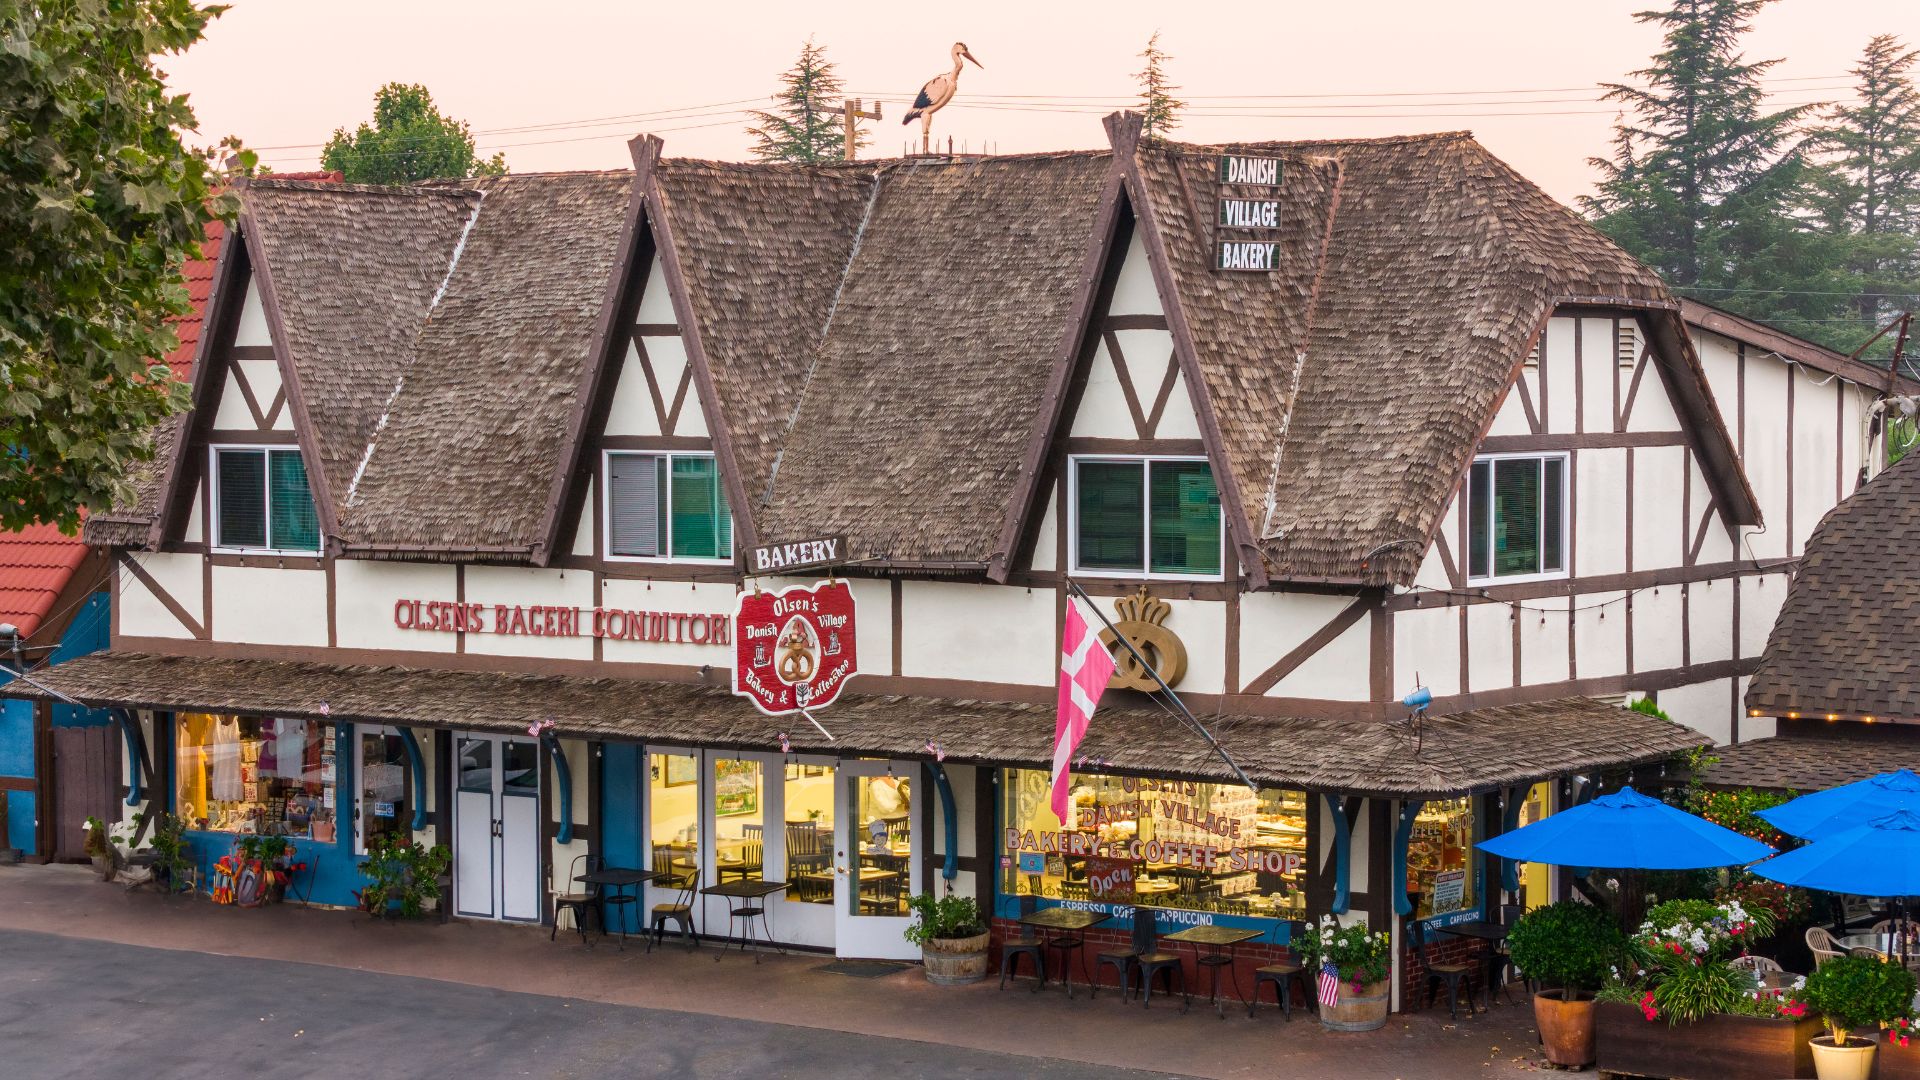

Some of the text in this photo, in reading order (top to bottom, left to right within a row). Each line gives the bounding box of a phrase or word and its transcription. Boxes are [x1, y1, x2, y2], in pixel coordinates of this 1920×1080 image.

[1228, 157, 1277, 185] DANISH
[1225, 200, 1278, 227] VILLAGE
[1223, 243, 1275, 269] BAKERY
[755, 538, 838, 570] BAKERY
[394, 599, 482, 632] OLSENS
[494, 604, 579, 637] BAGERI
[773, 596, 819, 617] Olsen's
[745, 613, 848, 640] Danish Village
[745, 667, 775, 704] Bakery
[779, 690, 788, 704] &
[1082, 800, 1241, 839] DANISH VILLAGE
[1006, 827, 1103, 856] BAKERY
[1130, 839, 1218, 869] COFFEE
[1230, 846, 1300, 876] SHOP
[1090, 868, 1133, 897] Open
[1112, 905, 1136, 919] COFF
[1154, 910, 1213, 926] CAPPUCCINO
